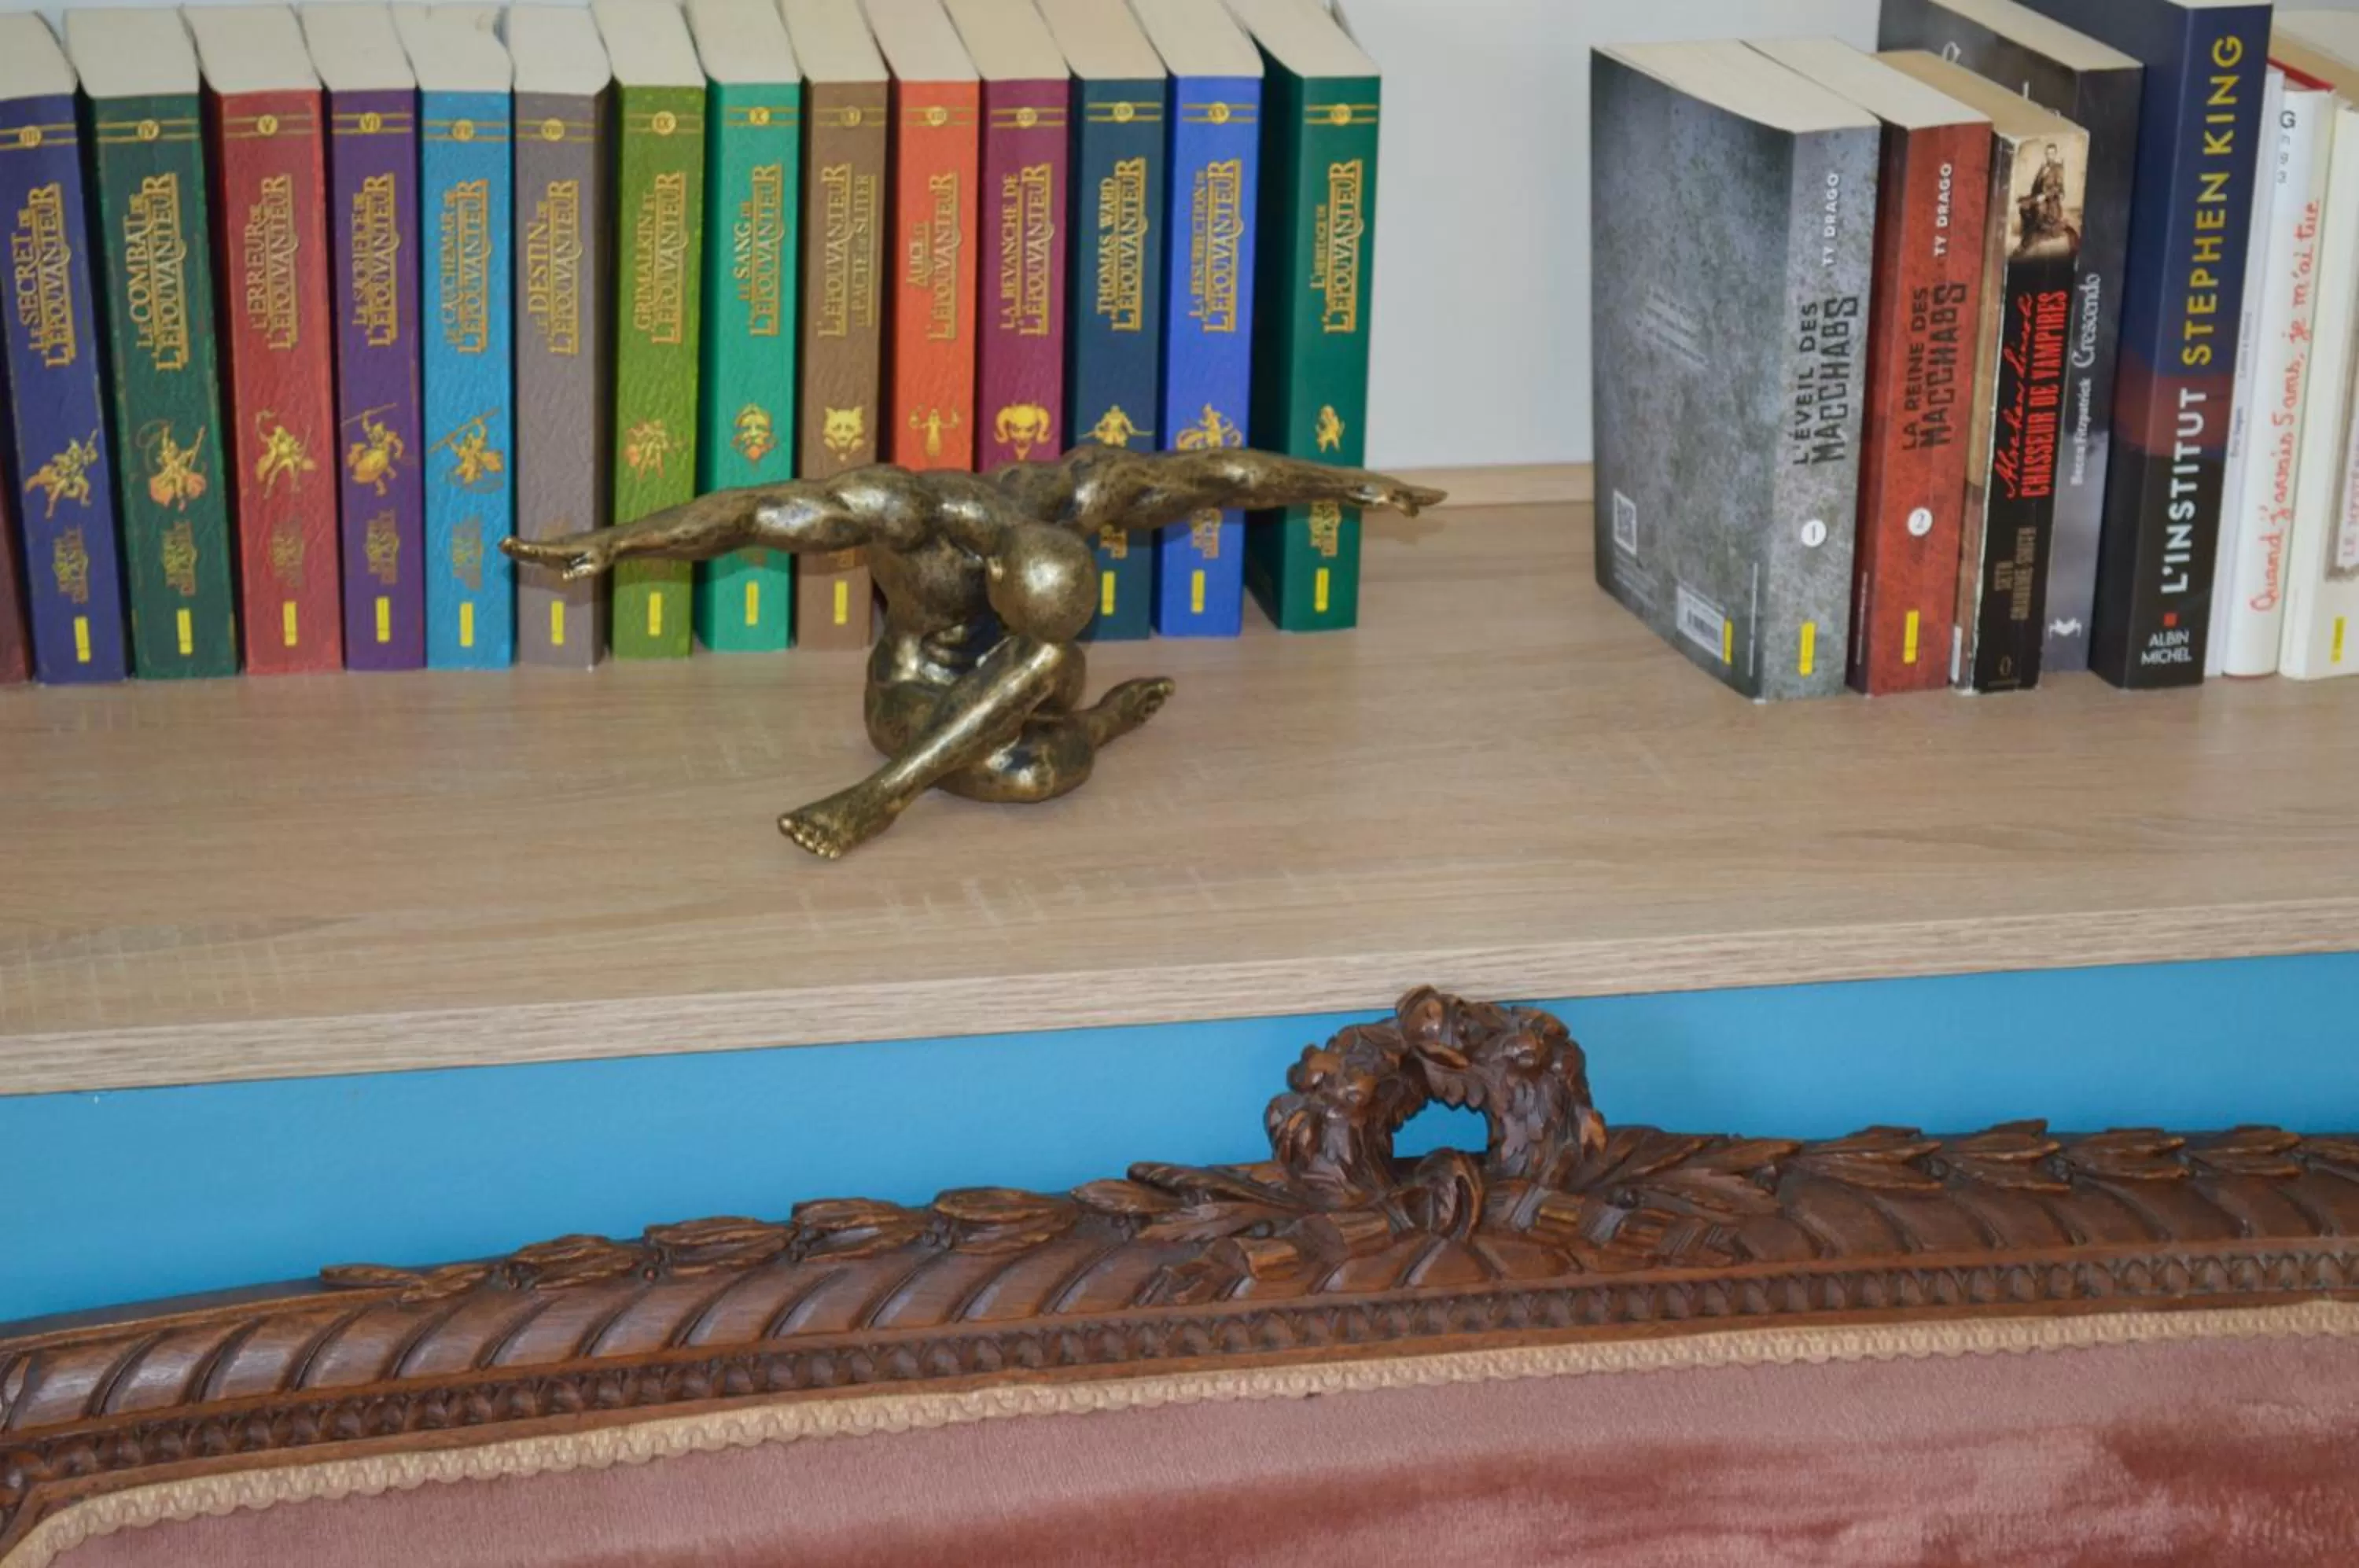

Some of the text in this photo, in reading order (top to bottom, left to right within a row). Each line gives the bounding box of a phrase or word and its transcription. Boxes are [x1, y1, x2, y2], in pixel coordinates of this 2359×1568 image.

[1822, 172, 1839, 266] TY DRAGO
[1934, 163, 1952, 256] TY DRAGO
[2182, 35, 2243, 365] STEPHEN KING
[11, 232, 40, 326] SECRET
[123, 214, 153, 322] COMBAT
[528, 221, 548, 314] DESTIN
[633, 213, 655, 331] GRIMALKIN
[734, 221, 751, 279] SANG
[852, 256, 868, 311] PACTE
[906, 239, 928, 287] ALICE
[999, 174, 1018, 329] LA REVANCHE DE
[1097, 235, 1114, 315] THOMAS
[1902, 287, 1928, 450] LA REINE DES
[1919, 283, 1967, 447] MACCHABS
[2031, 290, 2067, 381] VAMPIRES
[2071, 274, 2100, 369] Crescendo
[1789, 301, 1818, 466] L'ÉVEIL DES
[1812, 296, 1858, 464] MACCHABS
[2029, 384, 2059, 407] DE
[2021, 411, 2056, 498] CHASSEUR
[2161, 388, 2206, 594] L'INSTITUT
[2250, 532, 2282, 612] Quand
[2282, 318, 2313, 344] je
[2140, 646, 2193, 666] MICHEL
[2148, 631, 2190, 648] ALBIN
